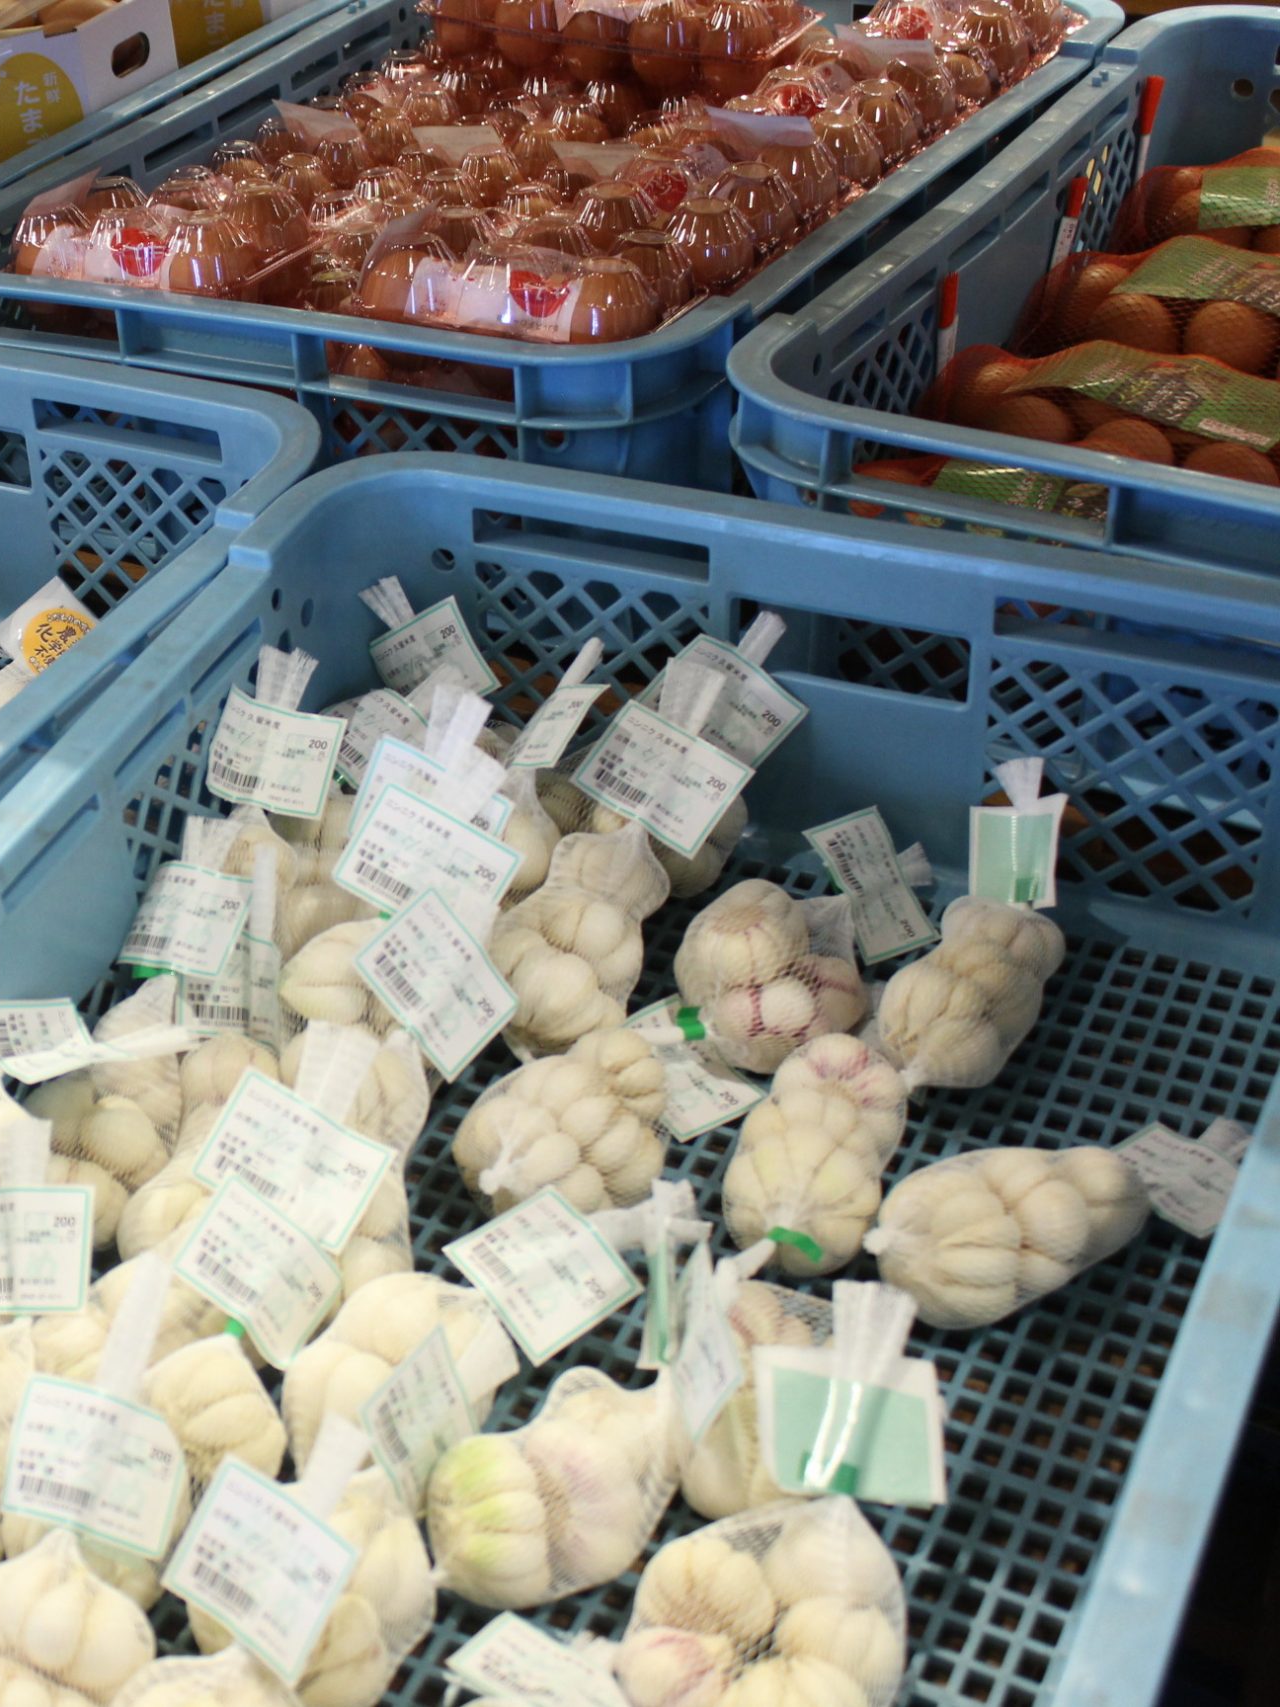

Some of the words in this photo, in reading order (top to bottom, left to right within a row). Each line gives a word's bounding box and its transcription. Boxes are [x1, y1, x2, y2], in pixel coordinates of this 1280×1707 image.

[440, 624, 456, 640] 200
[761, 709, 781, 728] 200
[308, 738, 328, 750] 200
[706, 775, 727, 792] 200
[474, 864, 497, 883] 200
[221, 899, 241, 911] 200
[477, 997, 496, 1019] 200
[720, 1090, 739, 1107] 200
[53, 1215, 77, 1228] 200
